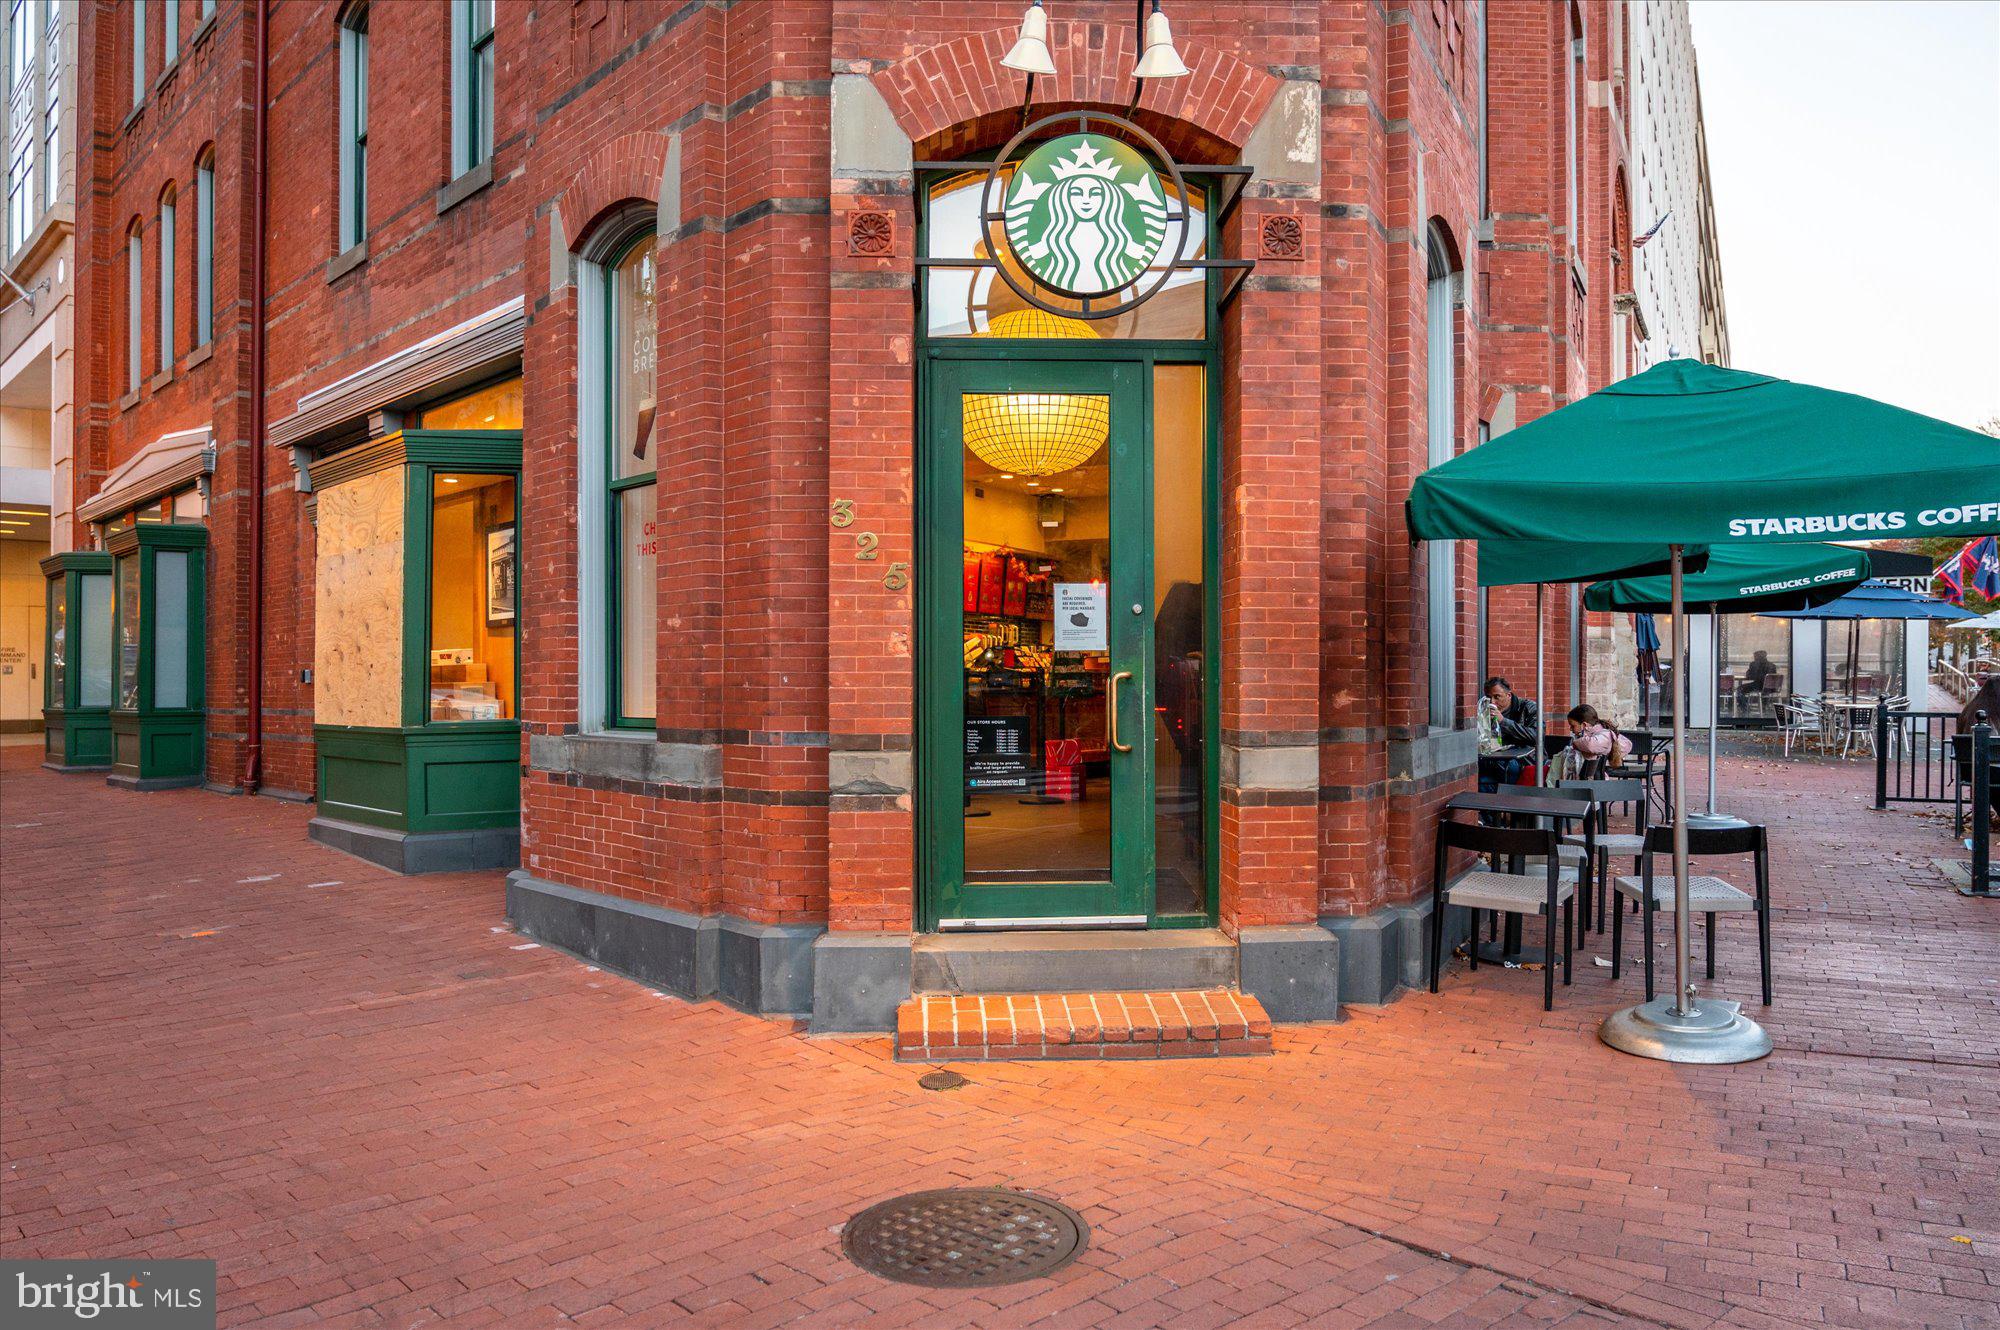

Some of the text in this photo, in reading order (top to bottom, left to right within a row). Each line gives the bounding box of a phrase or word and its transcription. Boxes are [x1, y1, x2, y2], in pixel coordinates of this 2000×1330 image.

[1729, 502, 2000, 536] STARBUCKS COFF
[636, 541, 657, 556] THIS
[1740, 568, 1856, 595] STARBUCKS COFFEE
